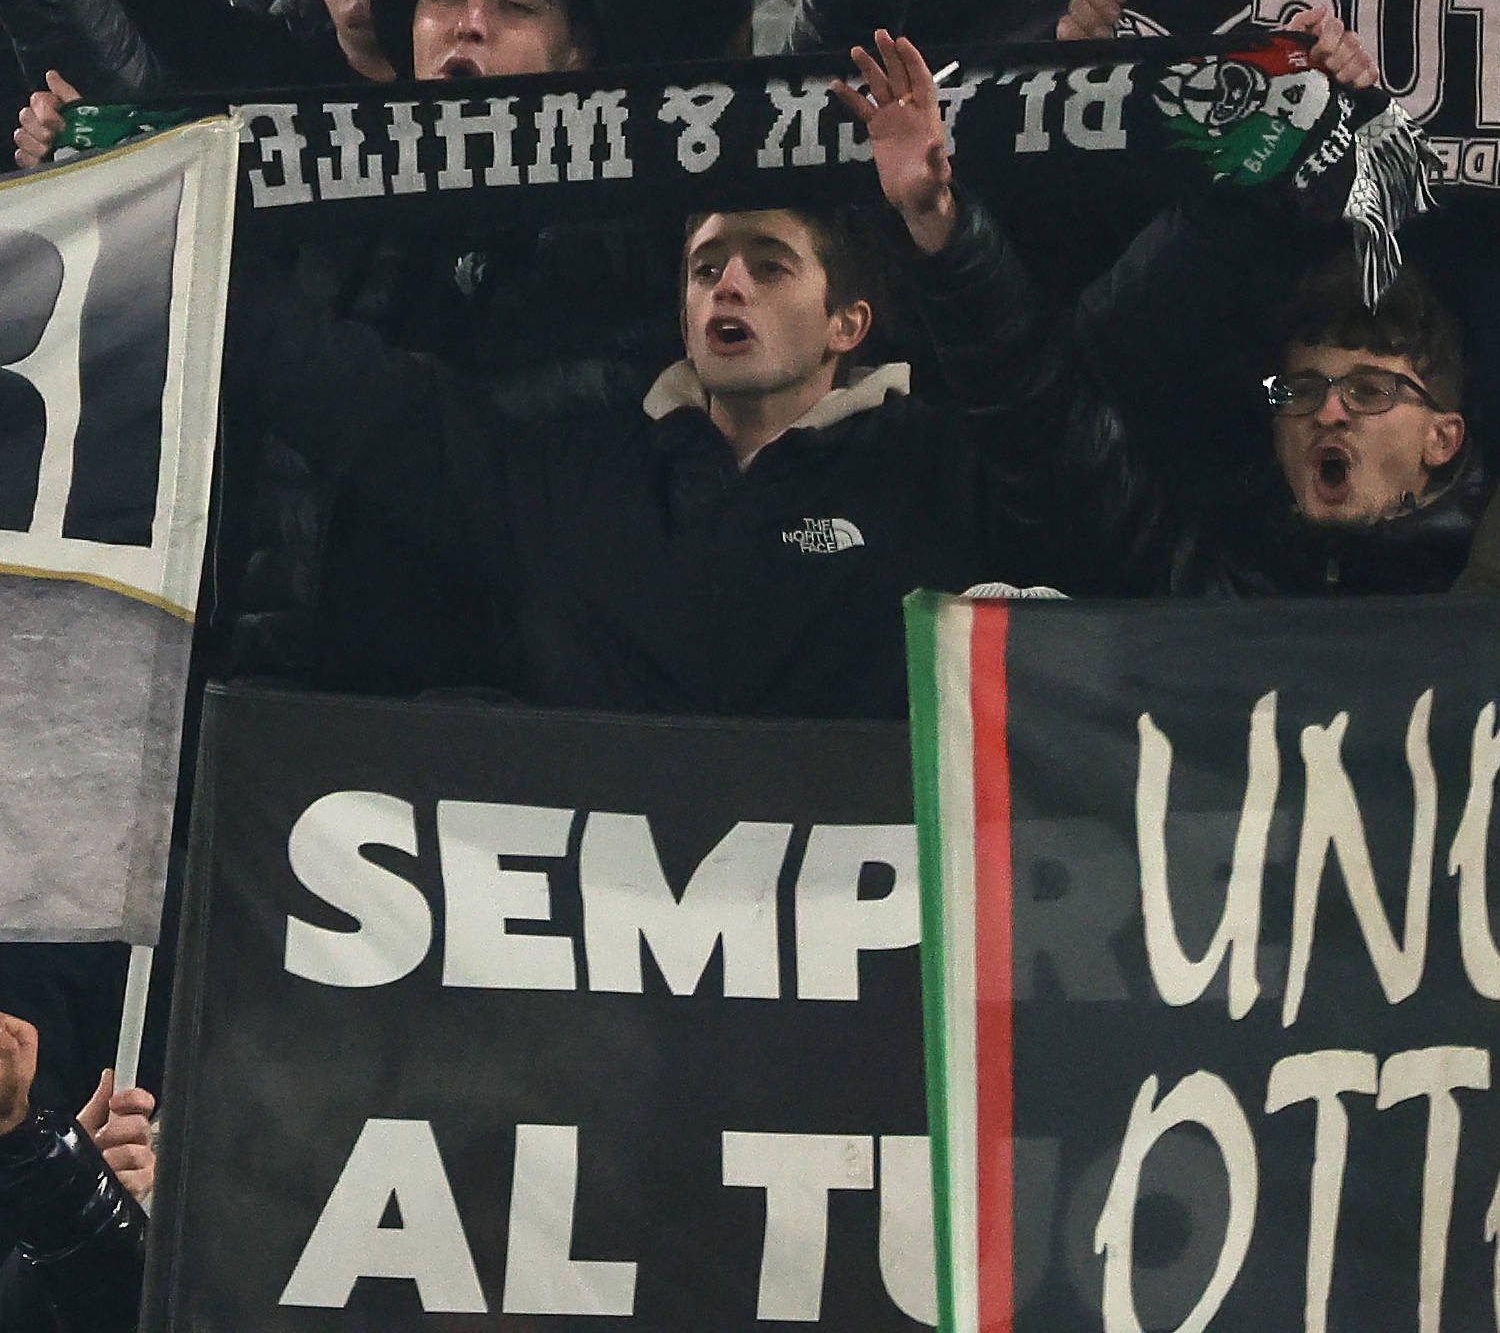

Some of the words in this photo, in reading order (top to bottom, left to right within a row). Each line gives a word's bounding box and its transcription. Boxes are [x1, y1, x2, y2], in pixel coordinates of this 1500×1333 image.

[241, 93, 603, 210] WHITE
[782, 529, 835, 544] NORTH
[800, 542, 838, 554] FACE
[804, 517, 831, 530] THE
[283, 789, 923, 1002] SEMP
[278, 1118, 638, 1317] AL
